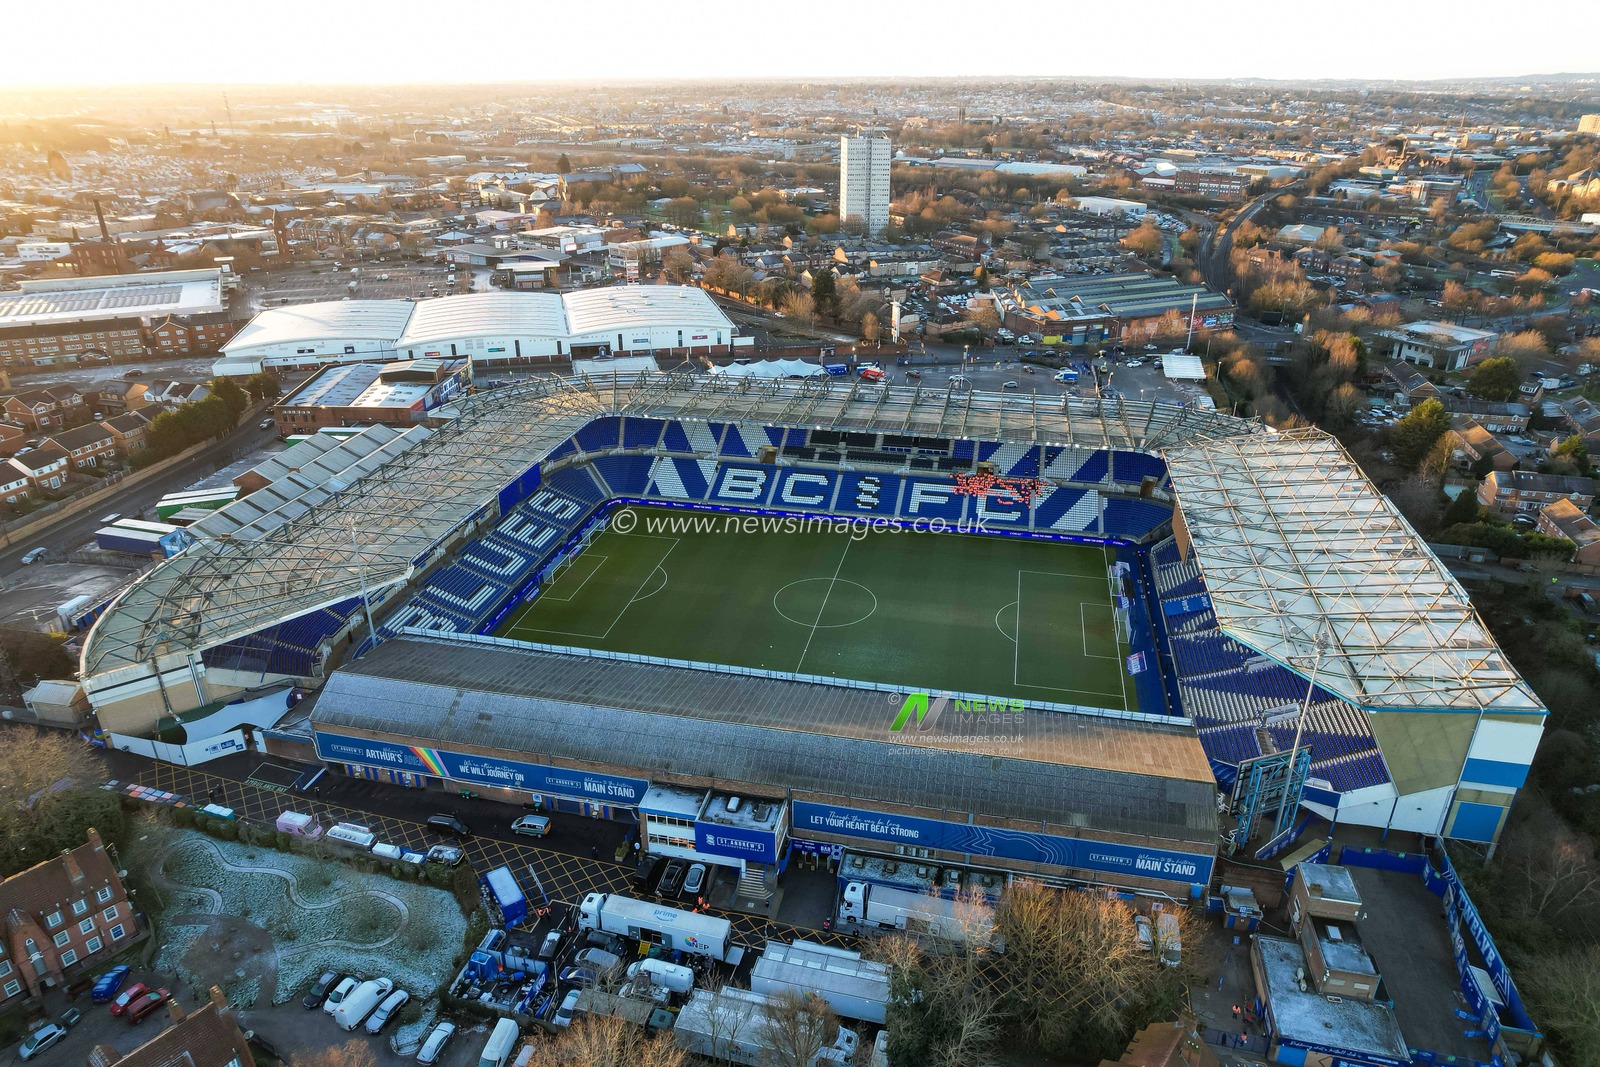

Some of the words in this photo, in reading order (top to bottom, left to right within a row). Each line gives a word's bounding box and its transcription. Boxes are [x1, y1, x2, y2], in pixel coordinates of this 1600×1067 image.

[365, 749, 403, 763] ARTHUR'S
[459, 764, 471, 774] WE
[471, 766, 486, 776] WILL
[486, 768, 514, 780] JOURNEY
[515, 773, 525, 782] ON
[584, 782, 607, 794] MAIN
[607, 786, 635, 799] STAND
[810, 815, 825, 825] LET
[825, 817, 845, 829] YOUR
[847, 820, 870, 832] HEART
[870, 823, 889, 835] BEAT
[890, 826, 919, 839] STRONG
[1135, 858, 1161, 872] MAIN
[1163, 861, 1196, 876] STAND
[654, 908, 678, 919] prime
[1457, 888, 1496, 969] TWELVE
[693, 941, 710, 951] NEP
